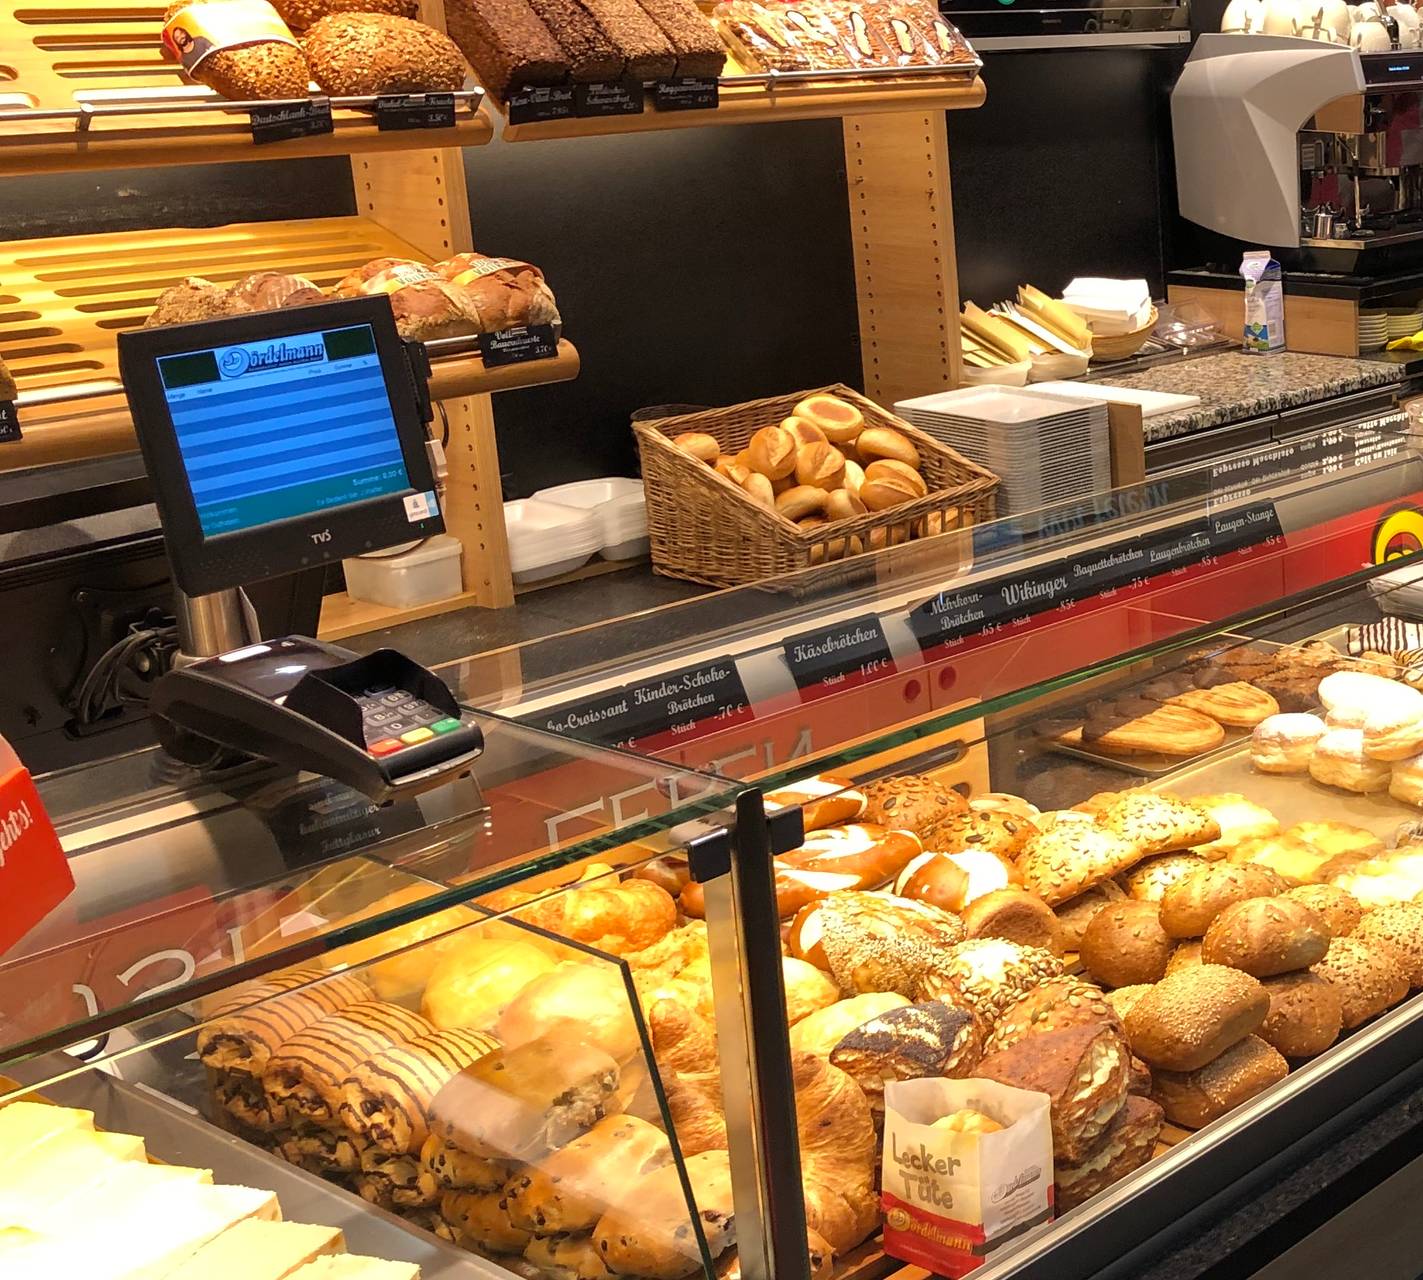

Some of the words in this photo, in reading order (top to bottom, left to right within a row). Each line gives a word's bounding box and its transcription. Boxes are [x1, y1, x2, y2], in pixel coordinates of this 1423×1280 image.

[1214, 508, 1274, 535] Laugen-Stange
[1073, 548, 1144, 579] Baguettebrötchen
[1149, 536, 1211, 563] Laugenbrötchen
[930, 593, 984, 617] Mehrkorn-
[1001, 575, 1069, 608] Wikinger
[940, 609, 985, 631] Brötchen
[1012, 615, 1032, 628] Stück
[793, 626, 879, 663] Käsebrötchen
[944, 635, 965, 649] Stück
[995, 622, 1002, 633] €
[634, 665, 731, 706] Kinder-Schoko-
[823, 672, 845, 687] Stück
[881, 657, 889, 669] €
[667, 692, 715, 716] Brötchen
[670, 721, 697, 736] Stück
[736, 702, 745, 714] €
[892, 1131, 961, 1177] Lecker
[899, 1168, 954, 1210] Tüte
